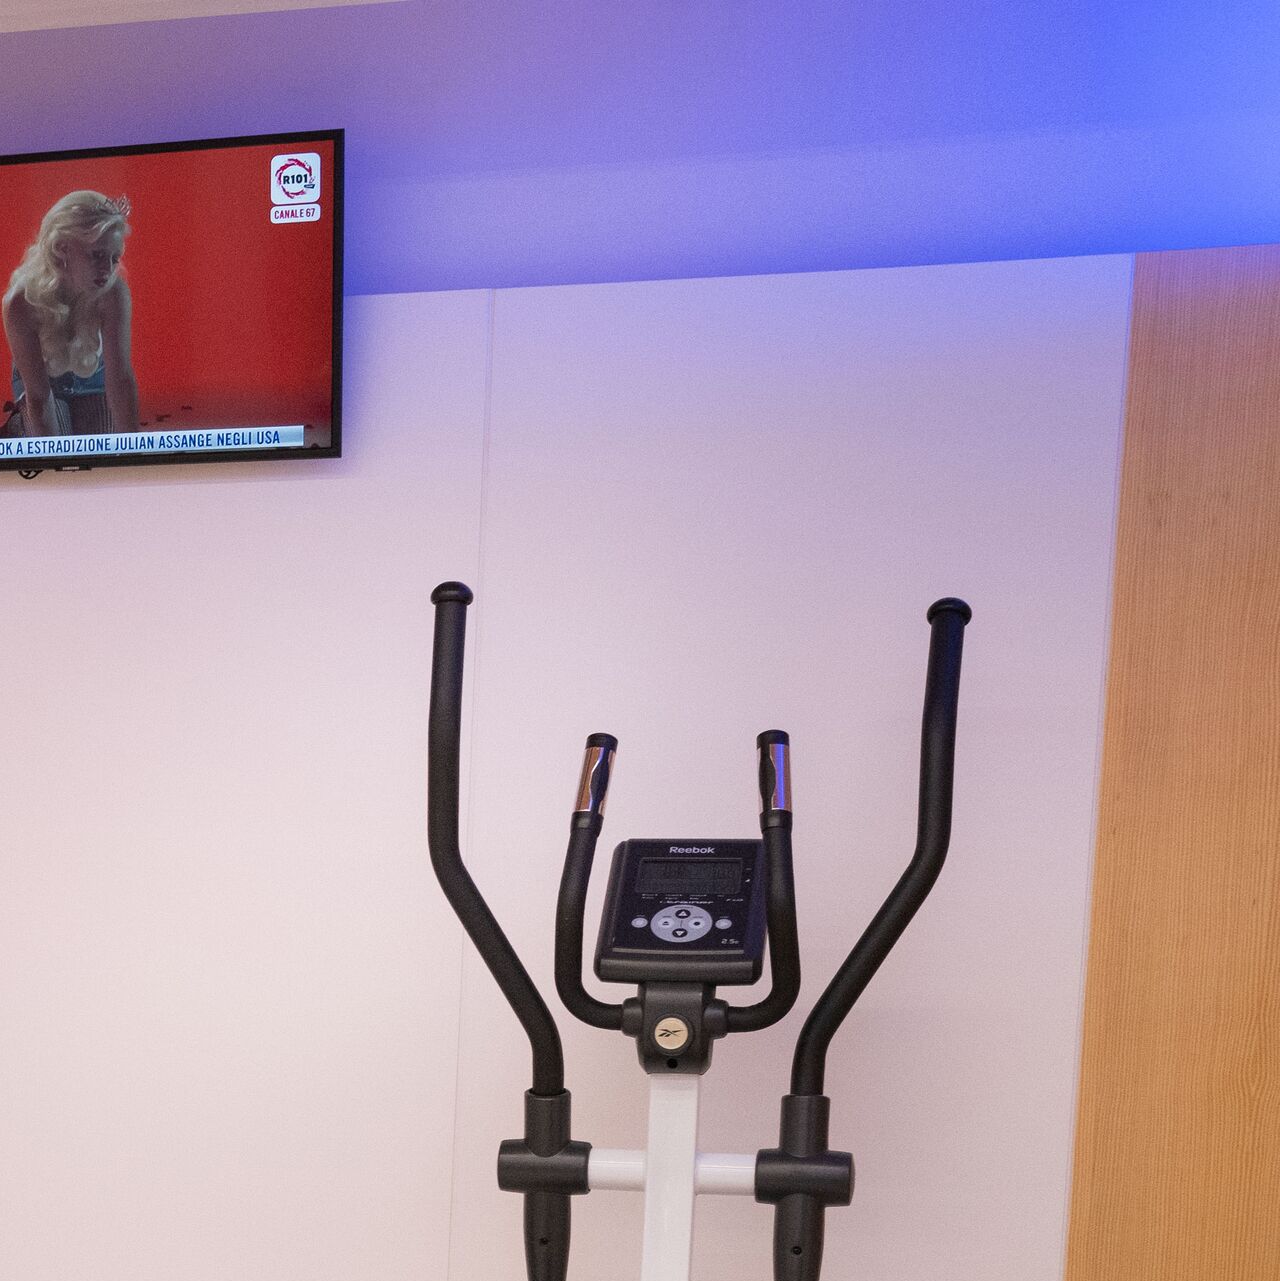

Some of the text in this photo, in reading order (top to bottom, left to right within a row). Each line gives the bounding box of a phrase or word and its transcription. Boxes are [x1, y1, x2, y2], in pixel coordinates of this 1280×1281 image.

[283, 173, 308, 185] R101
[274, 208, 316, 220] CANALE 67
[16, 441, 24, 455] A
[27, 437, 111, 454] ESTRADIZIONE
[114, 435, 154, 451] JULIAN
[158, 433, 212, 449] ASSANGE
[217, 431, 252, 446] NEGLI
[256, 430, 280, 445] USA
[669, 846, 715, 854] Reebok
